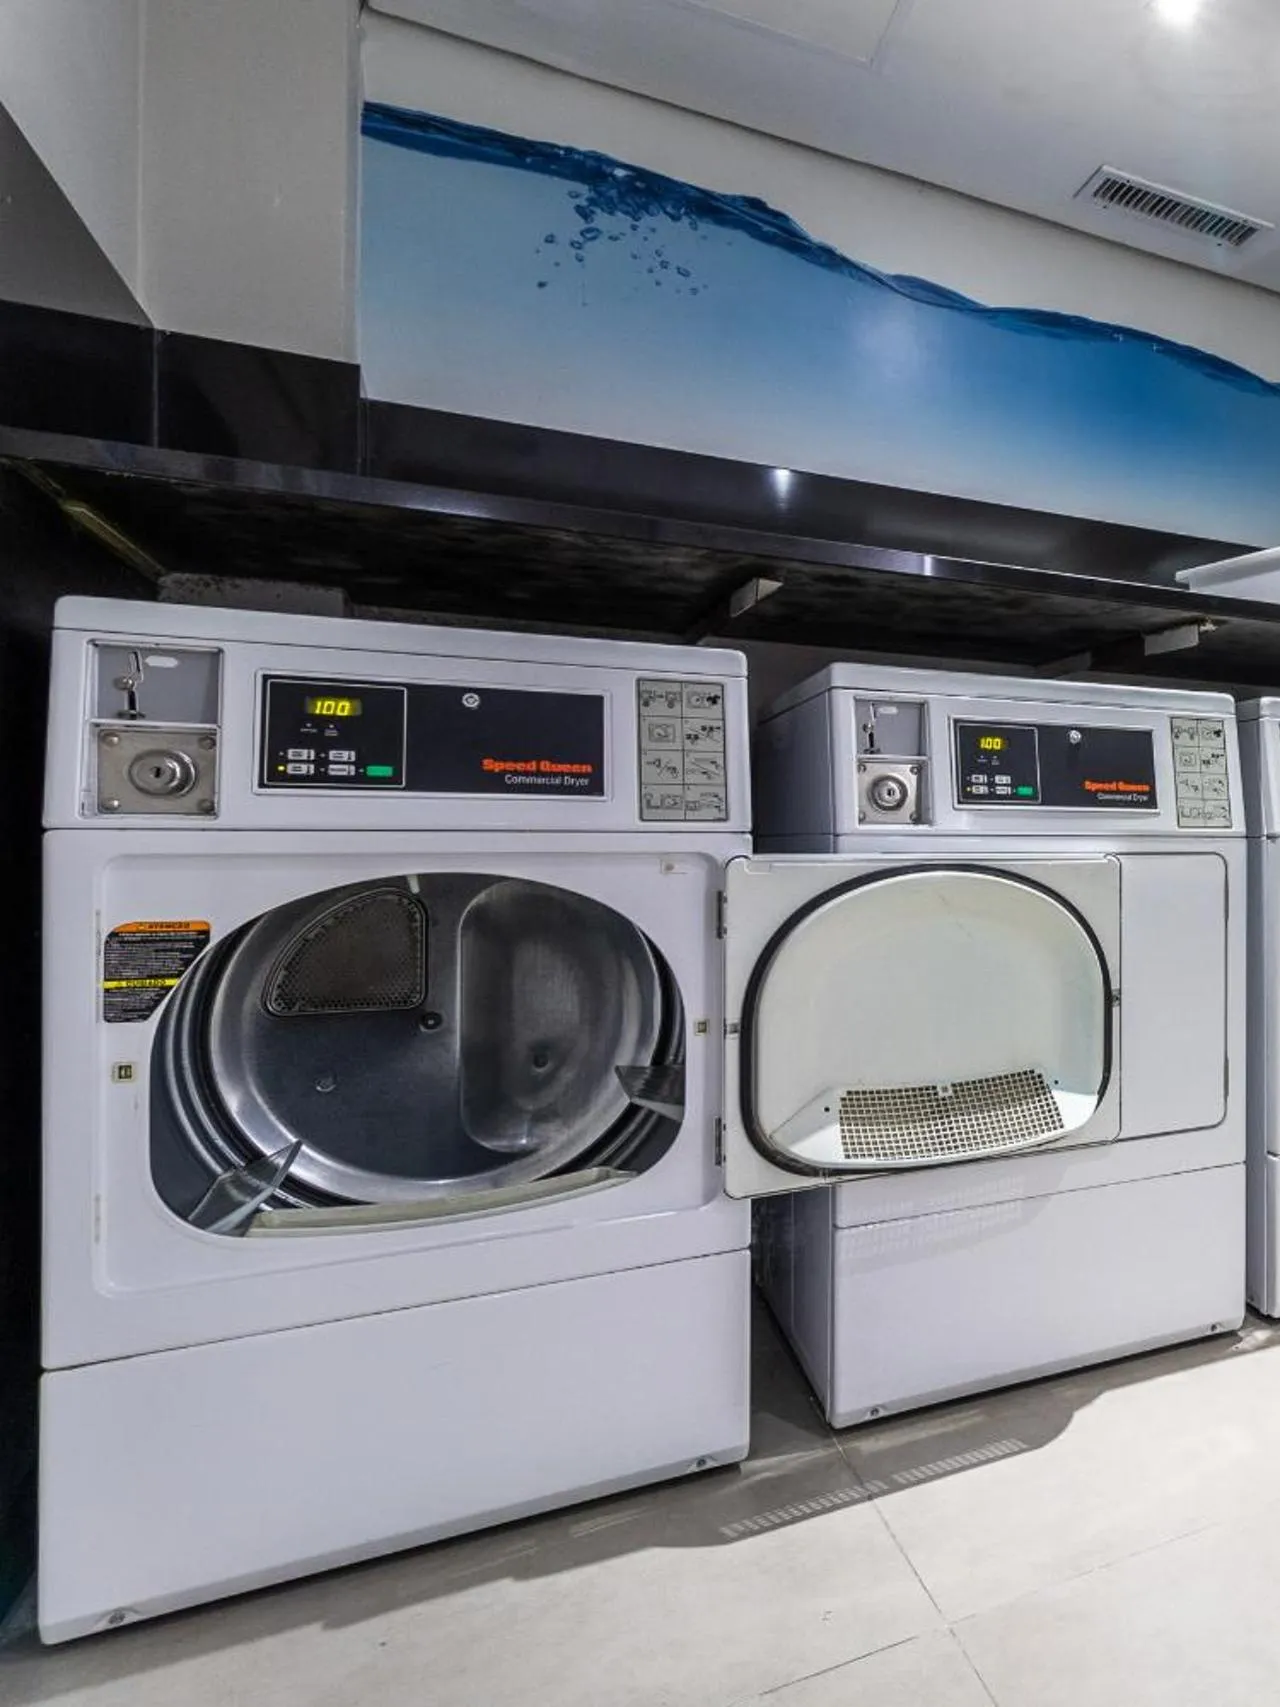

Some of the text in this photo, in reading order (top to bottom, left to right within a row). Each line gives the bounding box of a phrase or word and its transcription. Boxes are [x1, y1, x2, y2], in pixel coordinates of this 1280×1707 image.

[315, 701, 351, 716] 100
[980, 736, 1001, 750] 100
[482, 759, 593, 773] Speed Queen
[504, 774, 589, 787] Commercial Dryer
